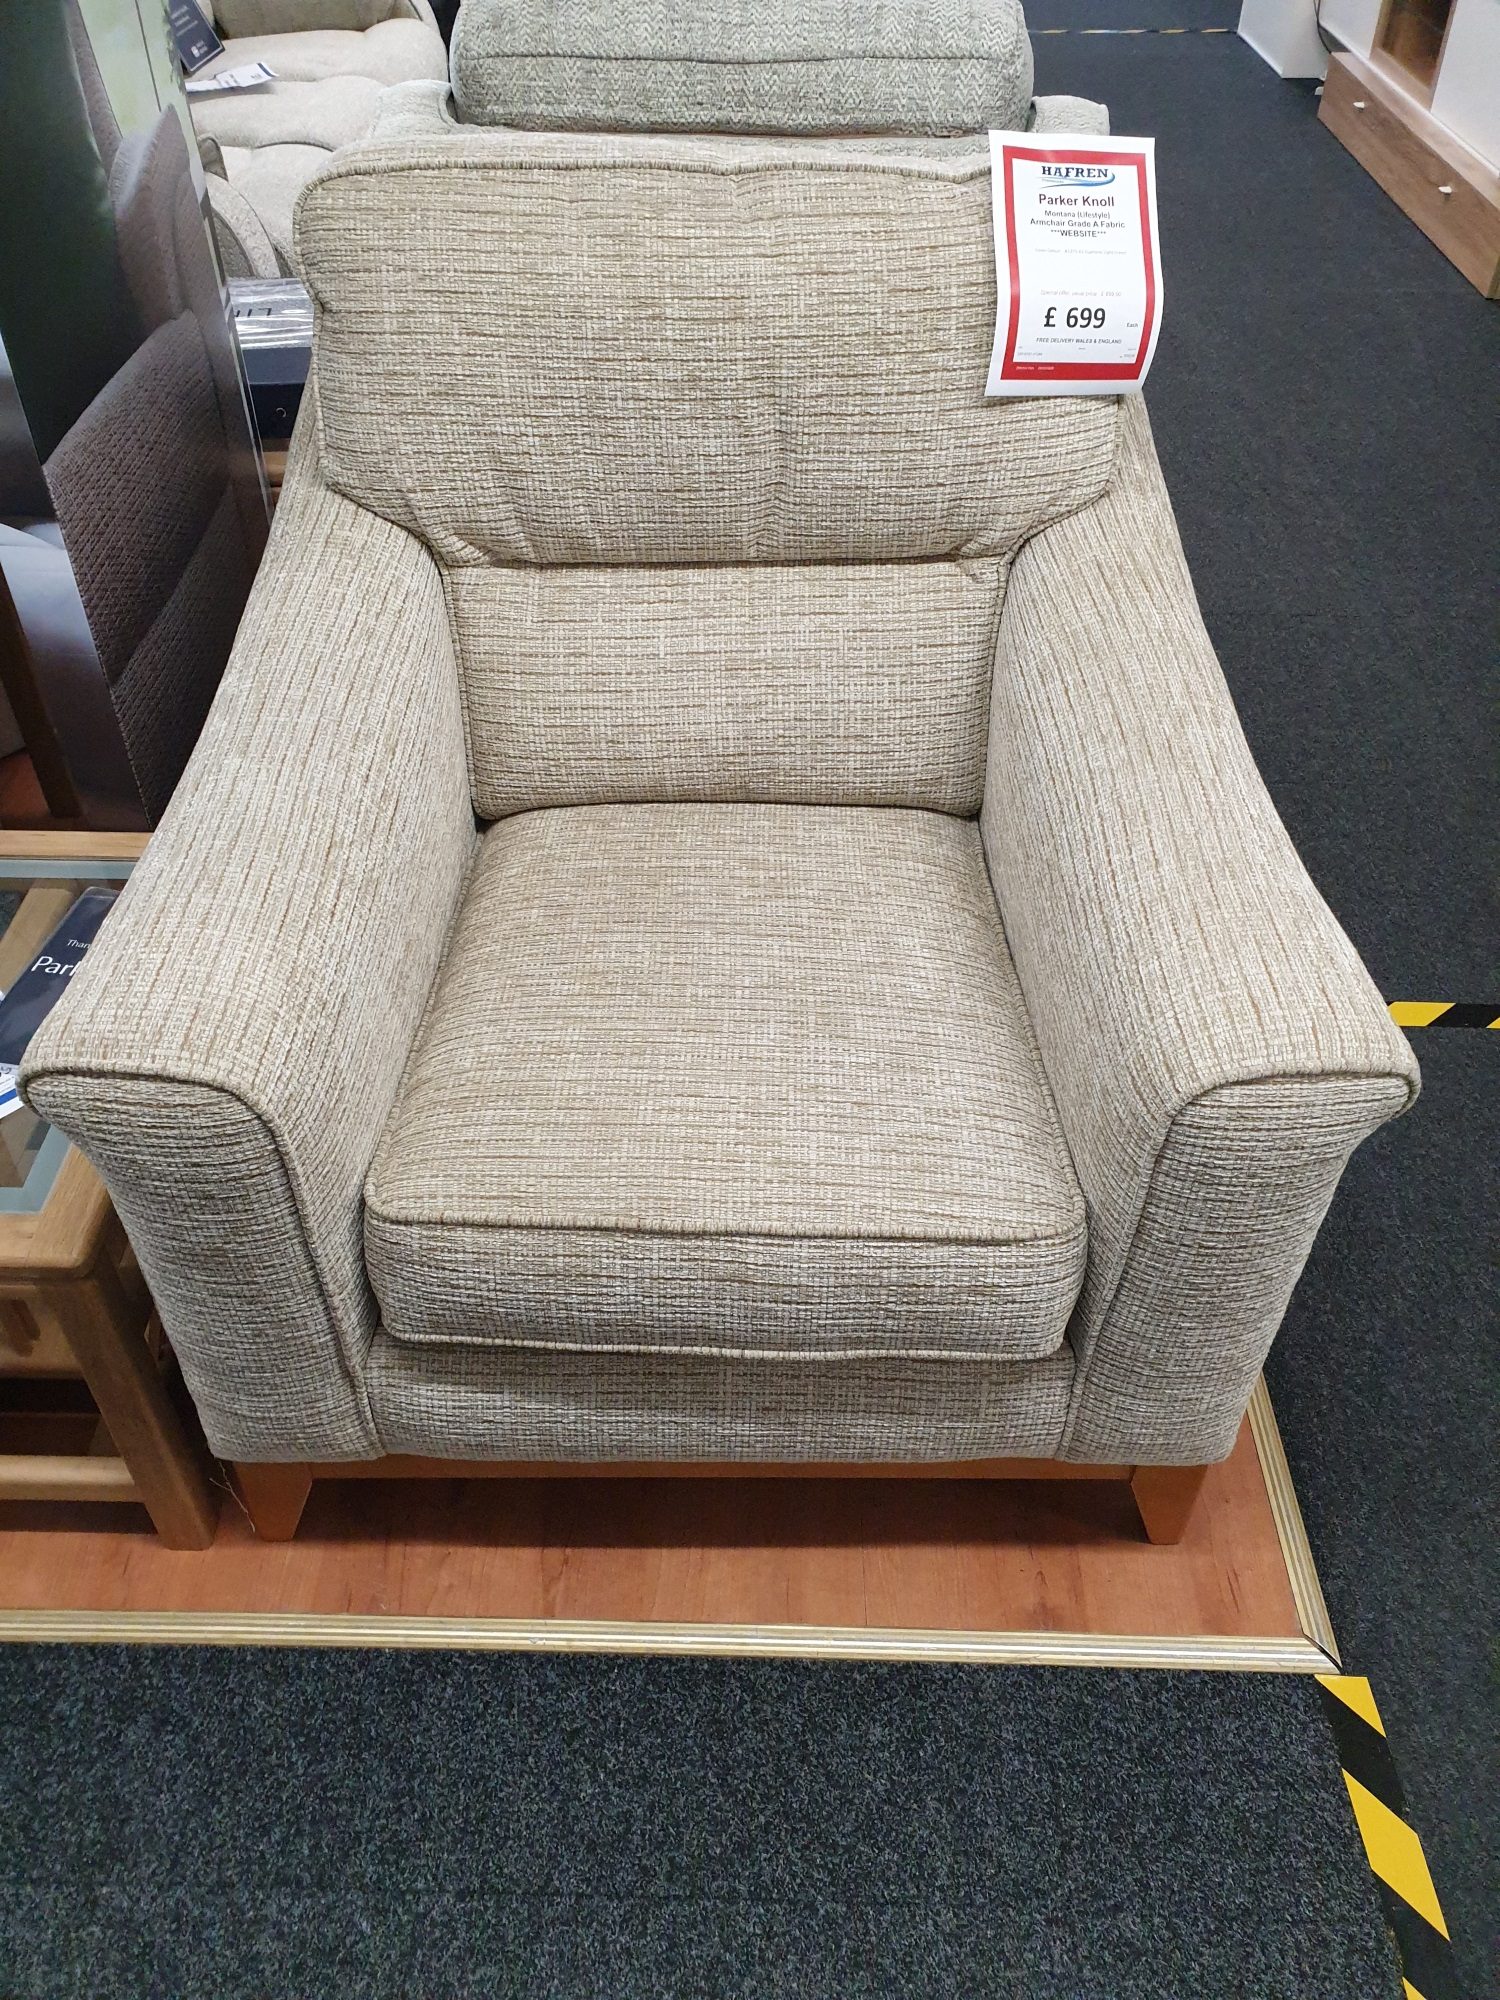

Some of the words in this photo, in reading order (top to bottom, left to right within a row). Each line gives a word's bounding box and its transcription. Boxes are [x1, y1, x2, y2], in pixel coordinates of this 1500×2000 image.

[1041, 165, 1109, 178] HAFREN
[1038, 193, 1078, 206] Parker
[1082, 195, 1115, 207] Knoll
[1044, 210, 1076, 218] Montana
[1077, 210, 1111, 220] (Lifestyle)
[1030, 218, 1066, 227] Armchair
[1067, 219, 1091, 228] Grade
[1092, 220, 1099, 228] A
[1100, 220, 1126, 228] Fabric
[1043, 306, 1057, 328] £
[1066, 306, 1106, 329] 699
